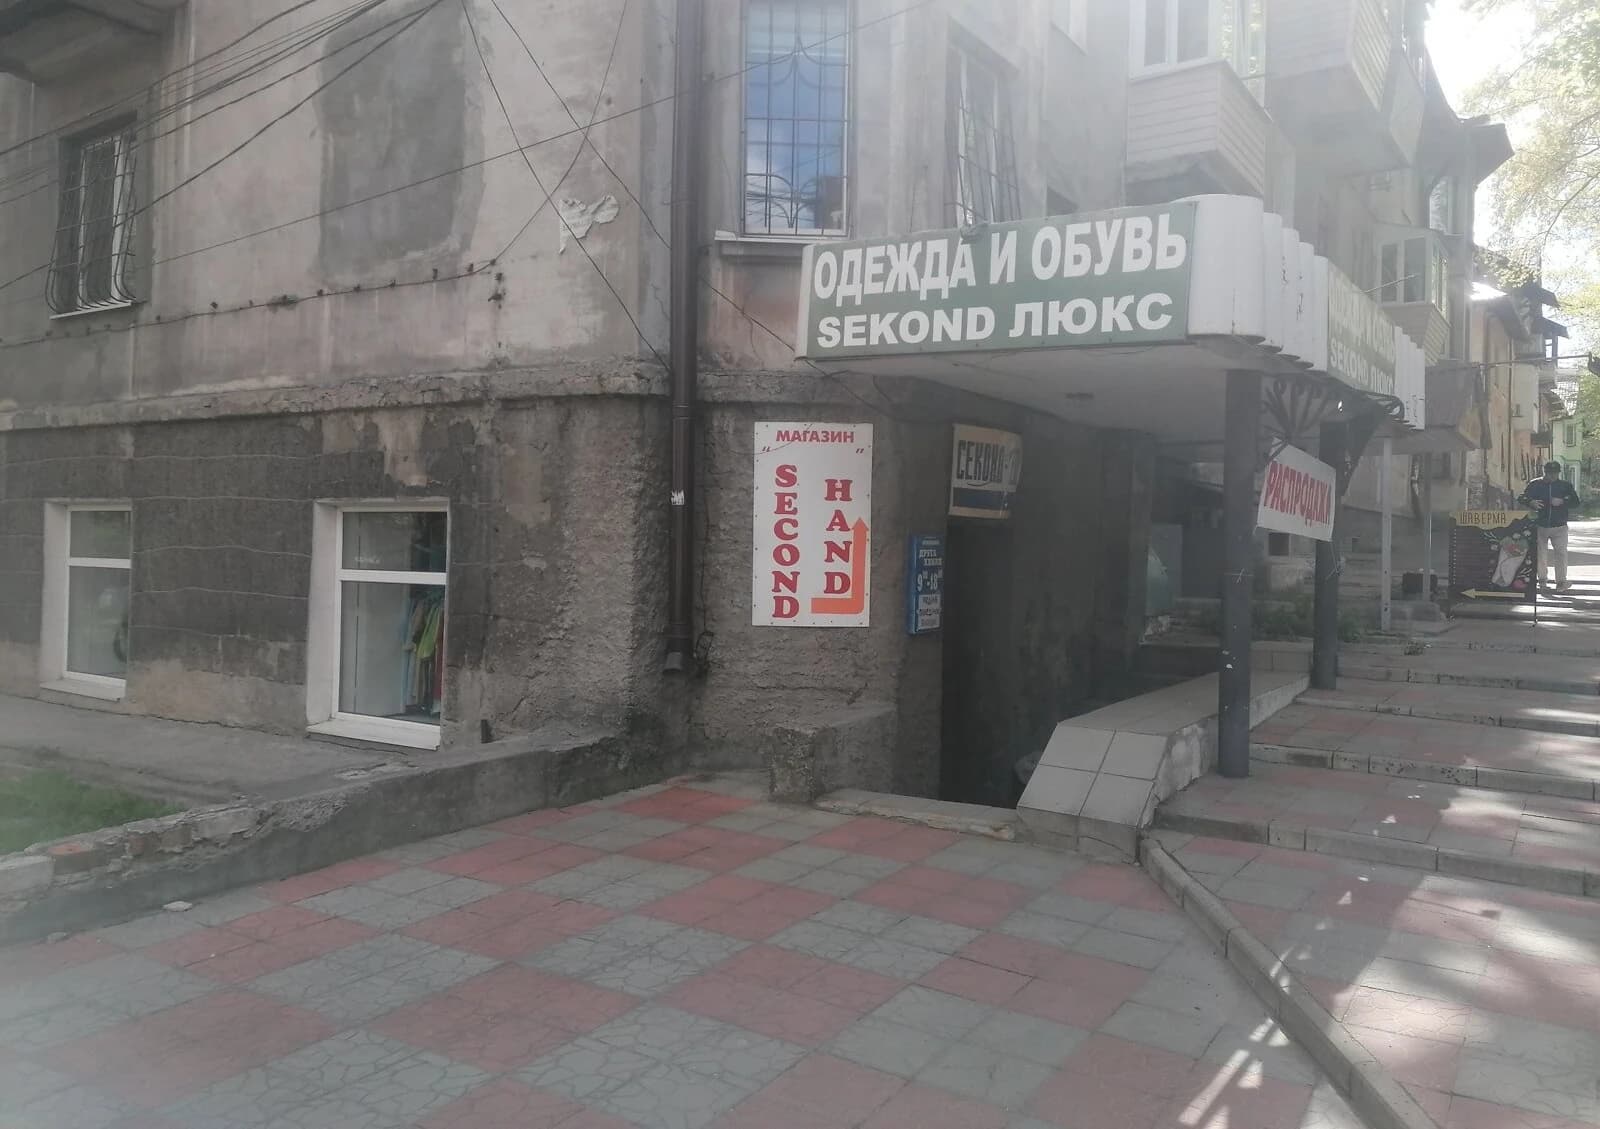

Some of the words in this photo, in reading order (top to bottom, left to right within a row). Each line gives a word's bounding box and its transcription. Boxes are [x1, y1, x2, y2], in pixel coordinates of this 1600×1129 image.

[814, 238, 977, 307] ОДЕЖДА
[989, 230, 1018, 286] И
[1031, 214, 1187, 281] ОБУВЬ
[817, 306, 996, 349] SEKOND
[1008, 293, 1173, 338] ЛЮКС
[776, 430, 855, 443] МАГАЗИН
[771, 464, 800, 619] SECOND
[823, 479, 853, 594] HAND
[1460, 511, 1507, 524] ШАВЕРМА
